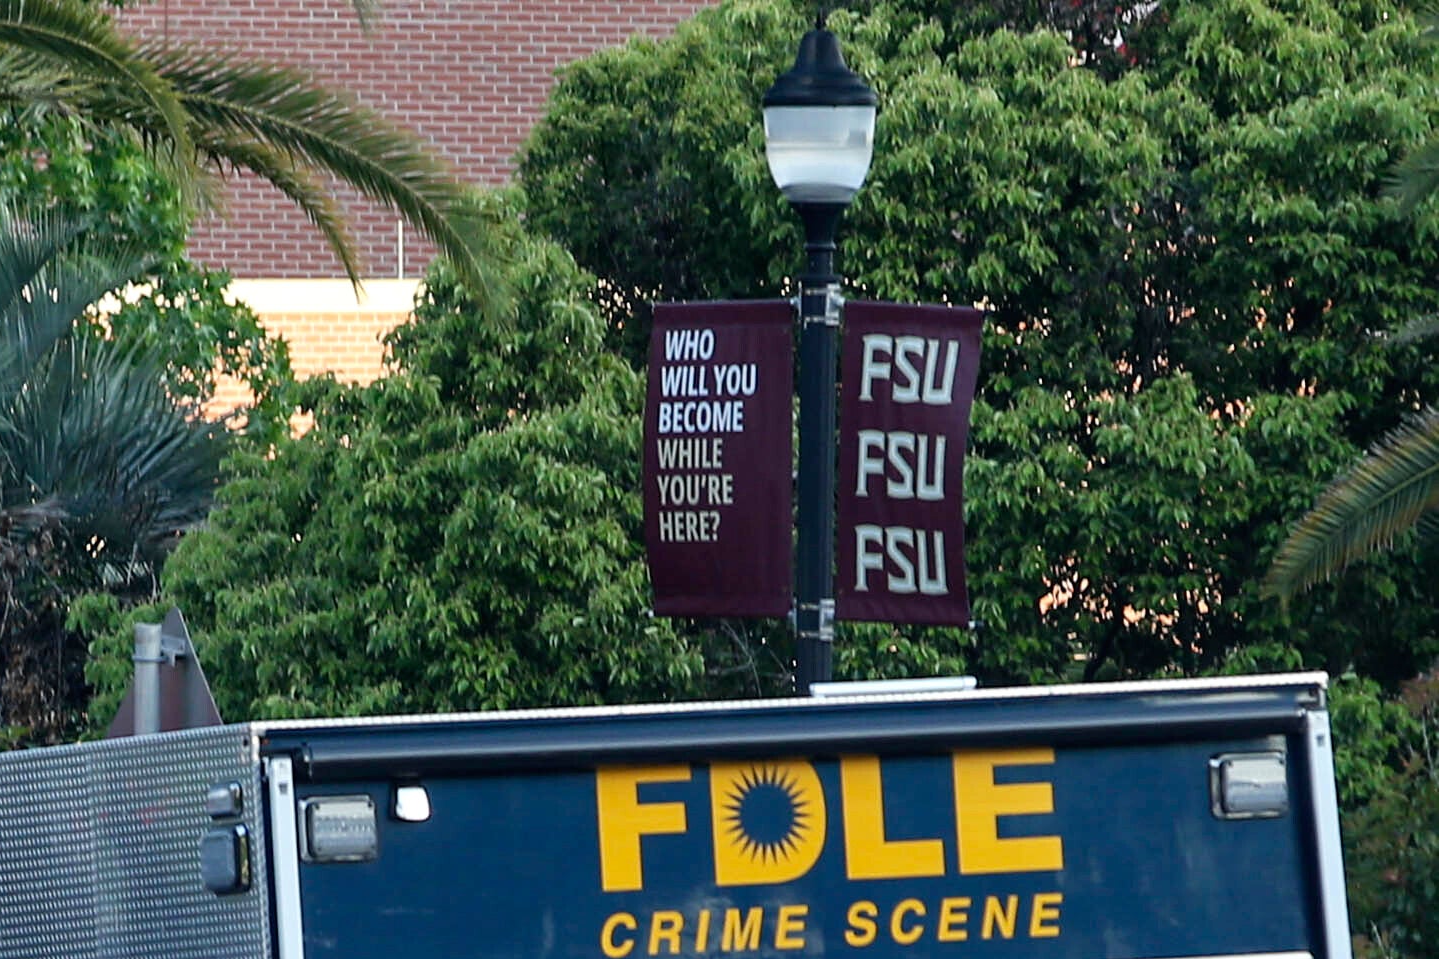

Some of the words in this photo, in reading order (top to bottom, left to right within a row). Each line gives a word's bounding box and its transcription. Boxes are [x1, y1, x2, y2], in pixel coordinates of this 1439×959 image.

[665, 328, 715, 361] WHO
[661, 365, 709, 397] WILL
[713, 363, 757, 396] YOU
[859, 334, 959, 405] FSU
[658, 400, 744, 434] BECOME
[657, 437, 723, 470] WHILE
[855, 429, 946, 501] FSU
[657, 474, 734, 506] YOU'RE
[659, 510, 721, 542] HERE?
[854, 524, 949, 595] FSU
[596, 747, 1064, 892] FDLE
[600, 904, 809, 959] CRIME
[844, 892, 1064, 947] SCENE
